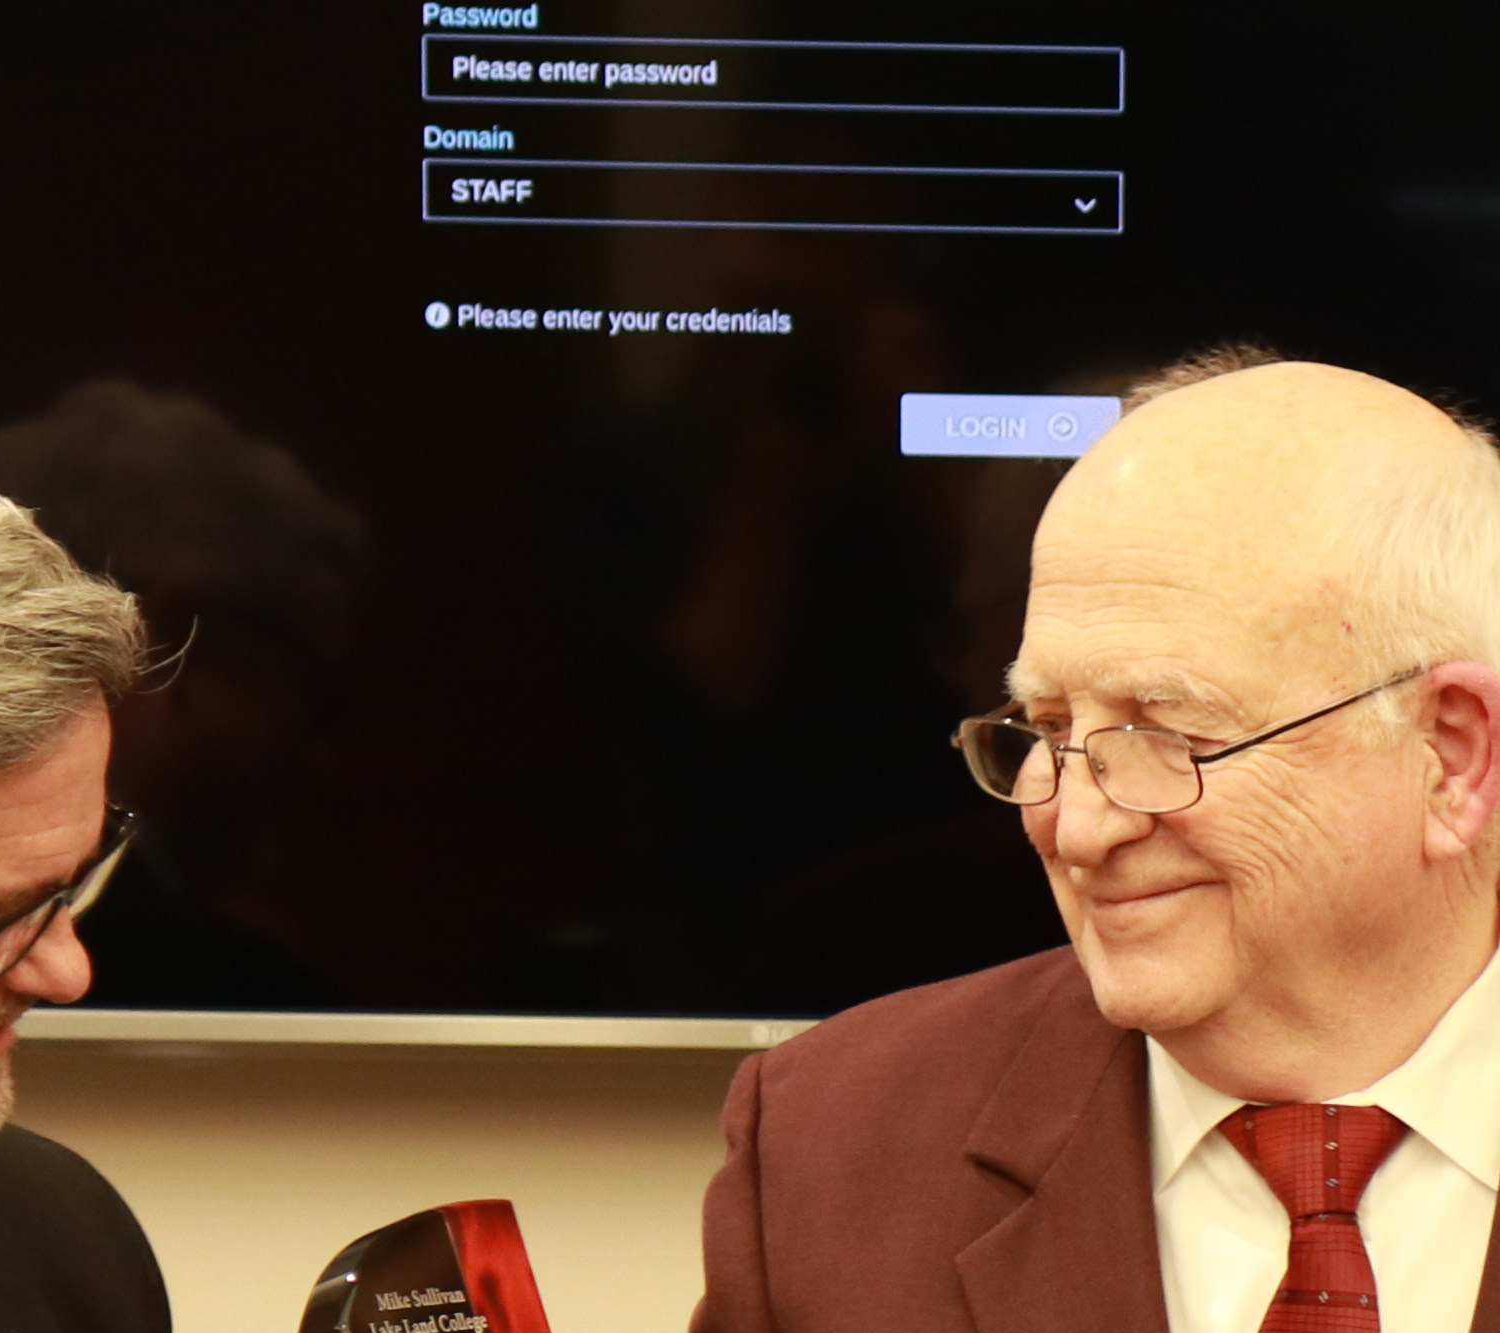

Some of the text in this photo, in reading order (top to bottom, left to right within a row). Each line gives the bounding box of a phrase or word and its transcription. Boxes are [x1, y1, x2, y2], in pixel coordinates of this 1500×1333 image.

[423, 3, 538, 28] Password
[452, 55, 718, 88] Please enter password
[423, 124, 515, 149] Domain
[451, 178, 533, 203] STAFF
[457, 303, 792, 336] Please enter your credentials
[946, 416, 1026, 438] LOGIN
[375, 1287, 466, 1311] Mike Sullivan
[438, 1312, 488, 1333] College
